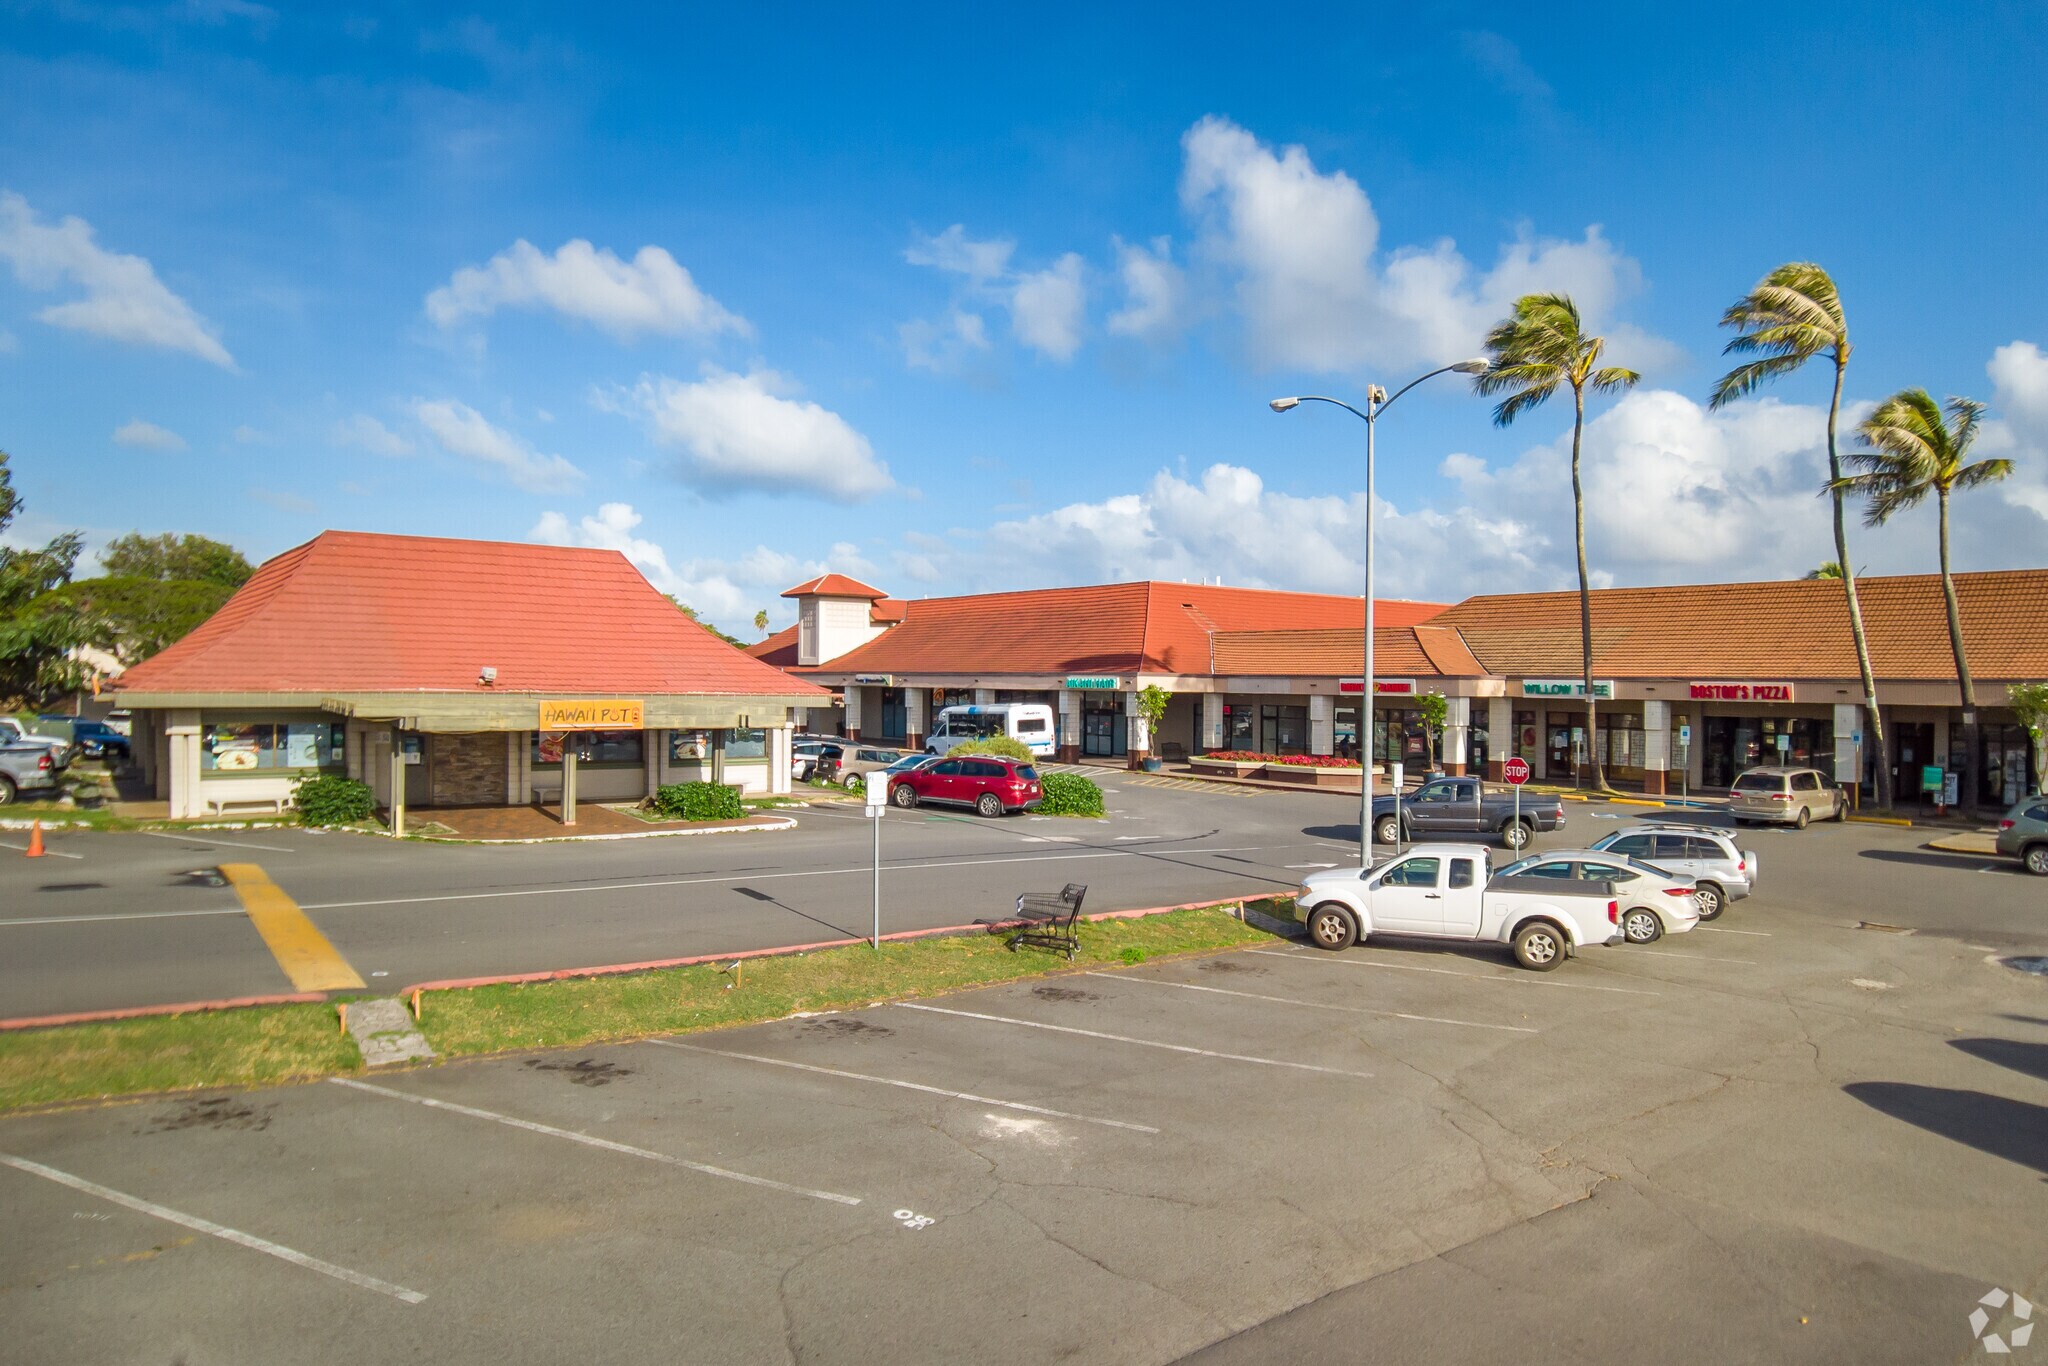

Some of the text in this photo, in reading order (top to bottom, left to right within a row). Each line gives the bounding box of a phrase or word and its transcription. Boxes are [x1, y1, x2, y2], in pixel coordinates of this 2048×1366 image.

[1523, 683, 1609, 696] WILLOW TEE
[1752, 685, 1790, 701] PIZZA
[601, 708, 630, 722] POT
[1506, 765, 1528, 777] STOP
